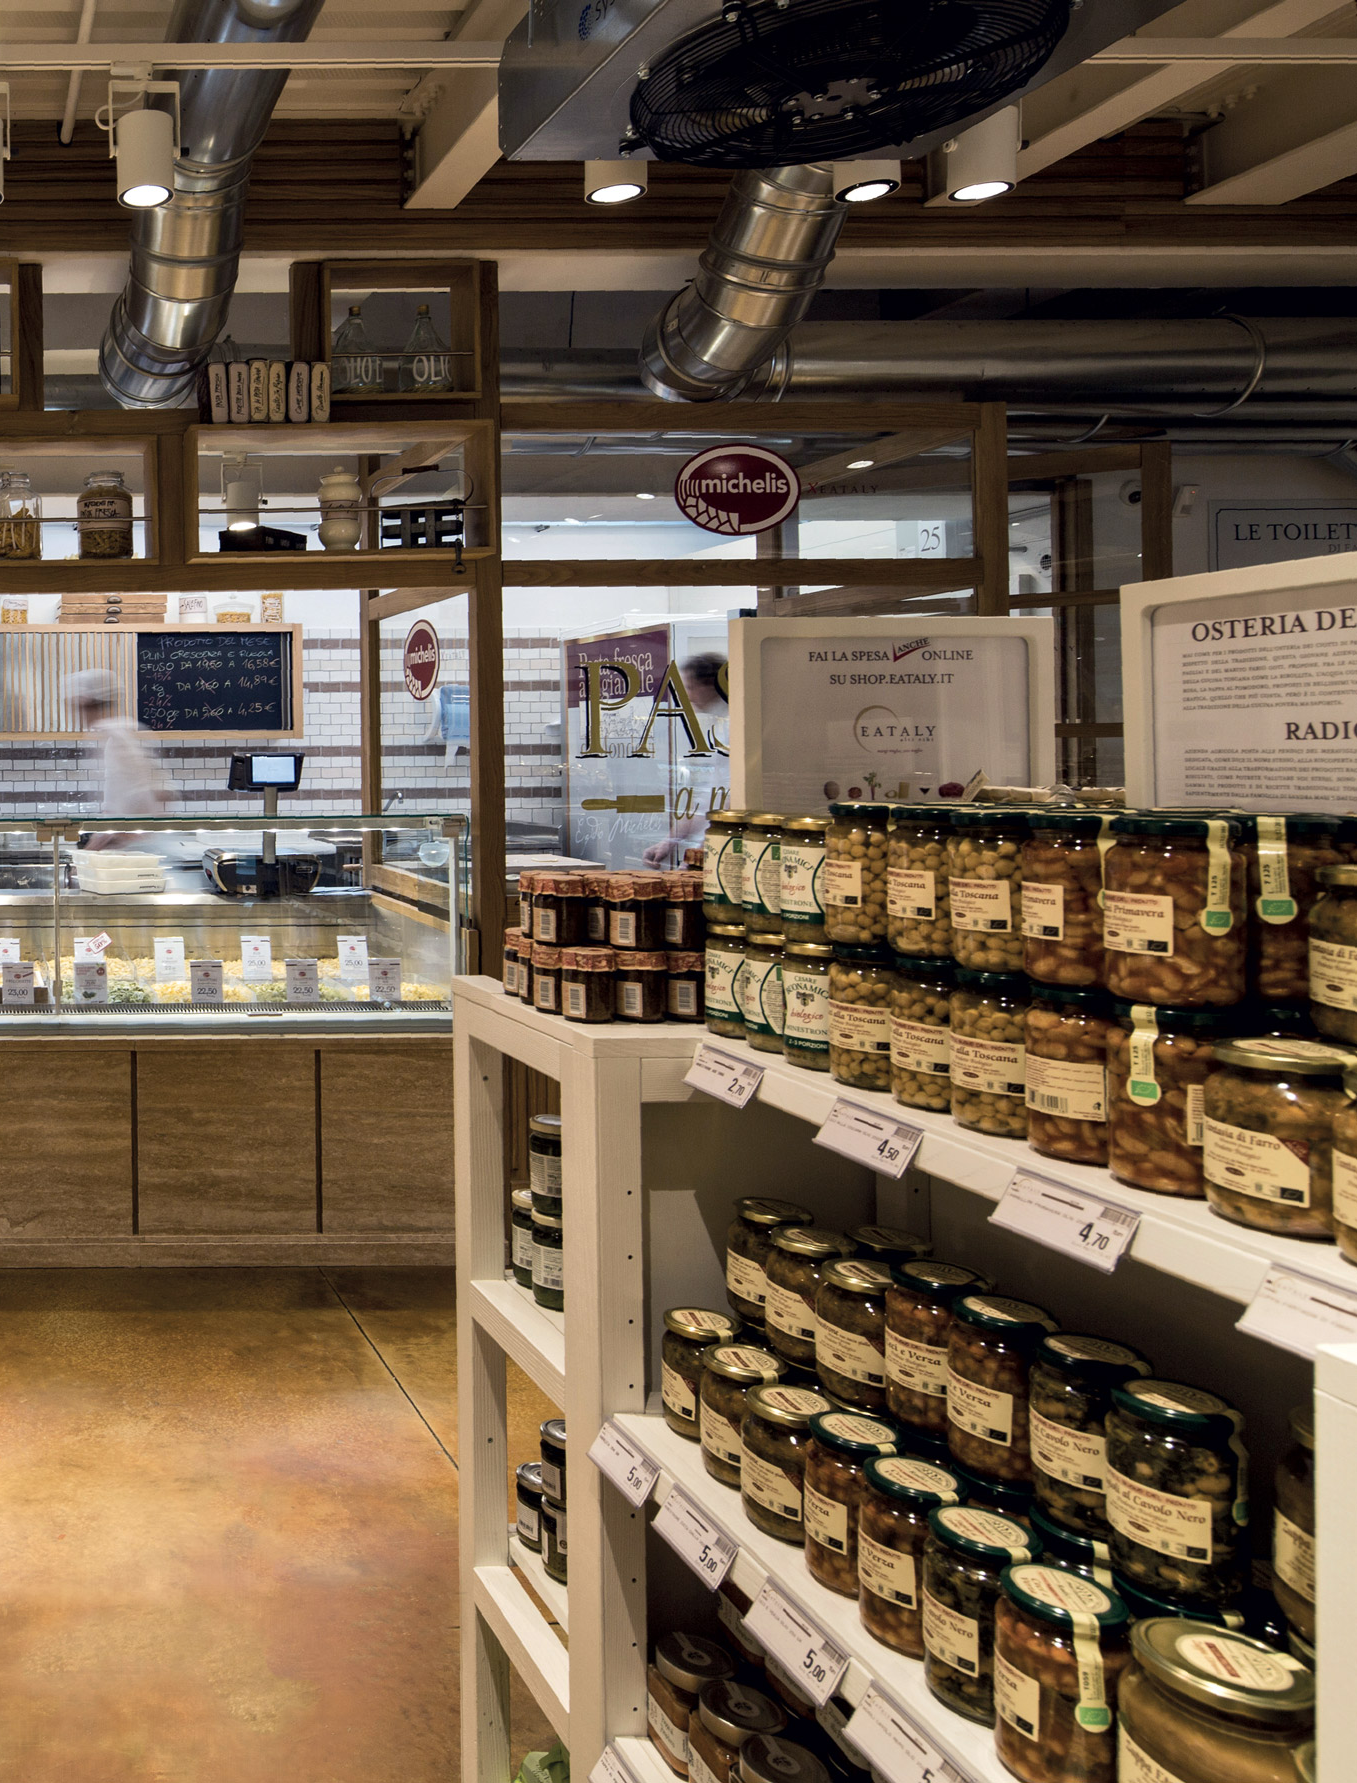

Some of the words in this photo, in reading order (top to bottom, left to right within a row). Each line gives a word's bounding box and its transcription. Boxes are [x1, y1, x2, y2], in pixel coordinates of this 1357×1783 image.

[701, 473, 788, 494] michelis
[920, 526, 940, 552] 25
[1234, 524, 1261, 540] LE
[1192, 613, 1308, 642] OSTERIA
[157, 634, 213, 650] PRODOTTO
[808, 651, 828, 662] FAI
[832, 651, 849, 661] LA
[851, 651, 890, 661] SPESA
[897, 637, 930, 653] ANCHE
[922, 650, 974, 661] ONLINE
[140, 662, 175, 672] SFUSO
[829, 674, 846, 685] SU
[849, 673, 955, 685] SHOP.EATALY.IT
[861, 726, 936, 737] EATALY
[1285, 720, 1357, 741] RADI
[893, 879, 926, 890] Toscana
[960, 889, 999, 900] Toscana
[1113, 904, 1165, 919] Primavera
[247, 959, 266, 967] 25,00
[344, 959, 363, 967] 25,00
[7, 988, 28, 996] 23,00
[196, 987, 217, 995] 22,50
[292, 986, 314, 994] 22,50
[846, 1013, 886, 1026] Toscana
[905, 1031, 944, 1046] Toscana
[972, 1050, 1018, 1064] Toscana
[727, 1078, 746, 1096] 2,70
[1236, 1131, 1247, 1144] di
[1249, 1135, 1281, 1151] Farro
[877, 1139, 900, 1161] 4,50
[1079, 1222, 1110, 1250] 4,70
[907, 1350, 942, 1367] Verza
[959, 1386, 992, 1409] Verza
[1073, 1440, 1100, 1457] Nero
[627, 1466, 643, 1491] 5,00
[1133, 1494, 1172, 1517] Cavolo
[1176, 1510, 1206, 1525] Nero
[698, 1545, 718, 1574] 5,00
[866, 1547, 895, 1570] Verza
[949, 1621, 974, 1640] Nero
[803, 1648, 827, 1684] 5,00
